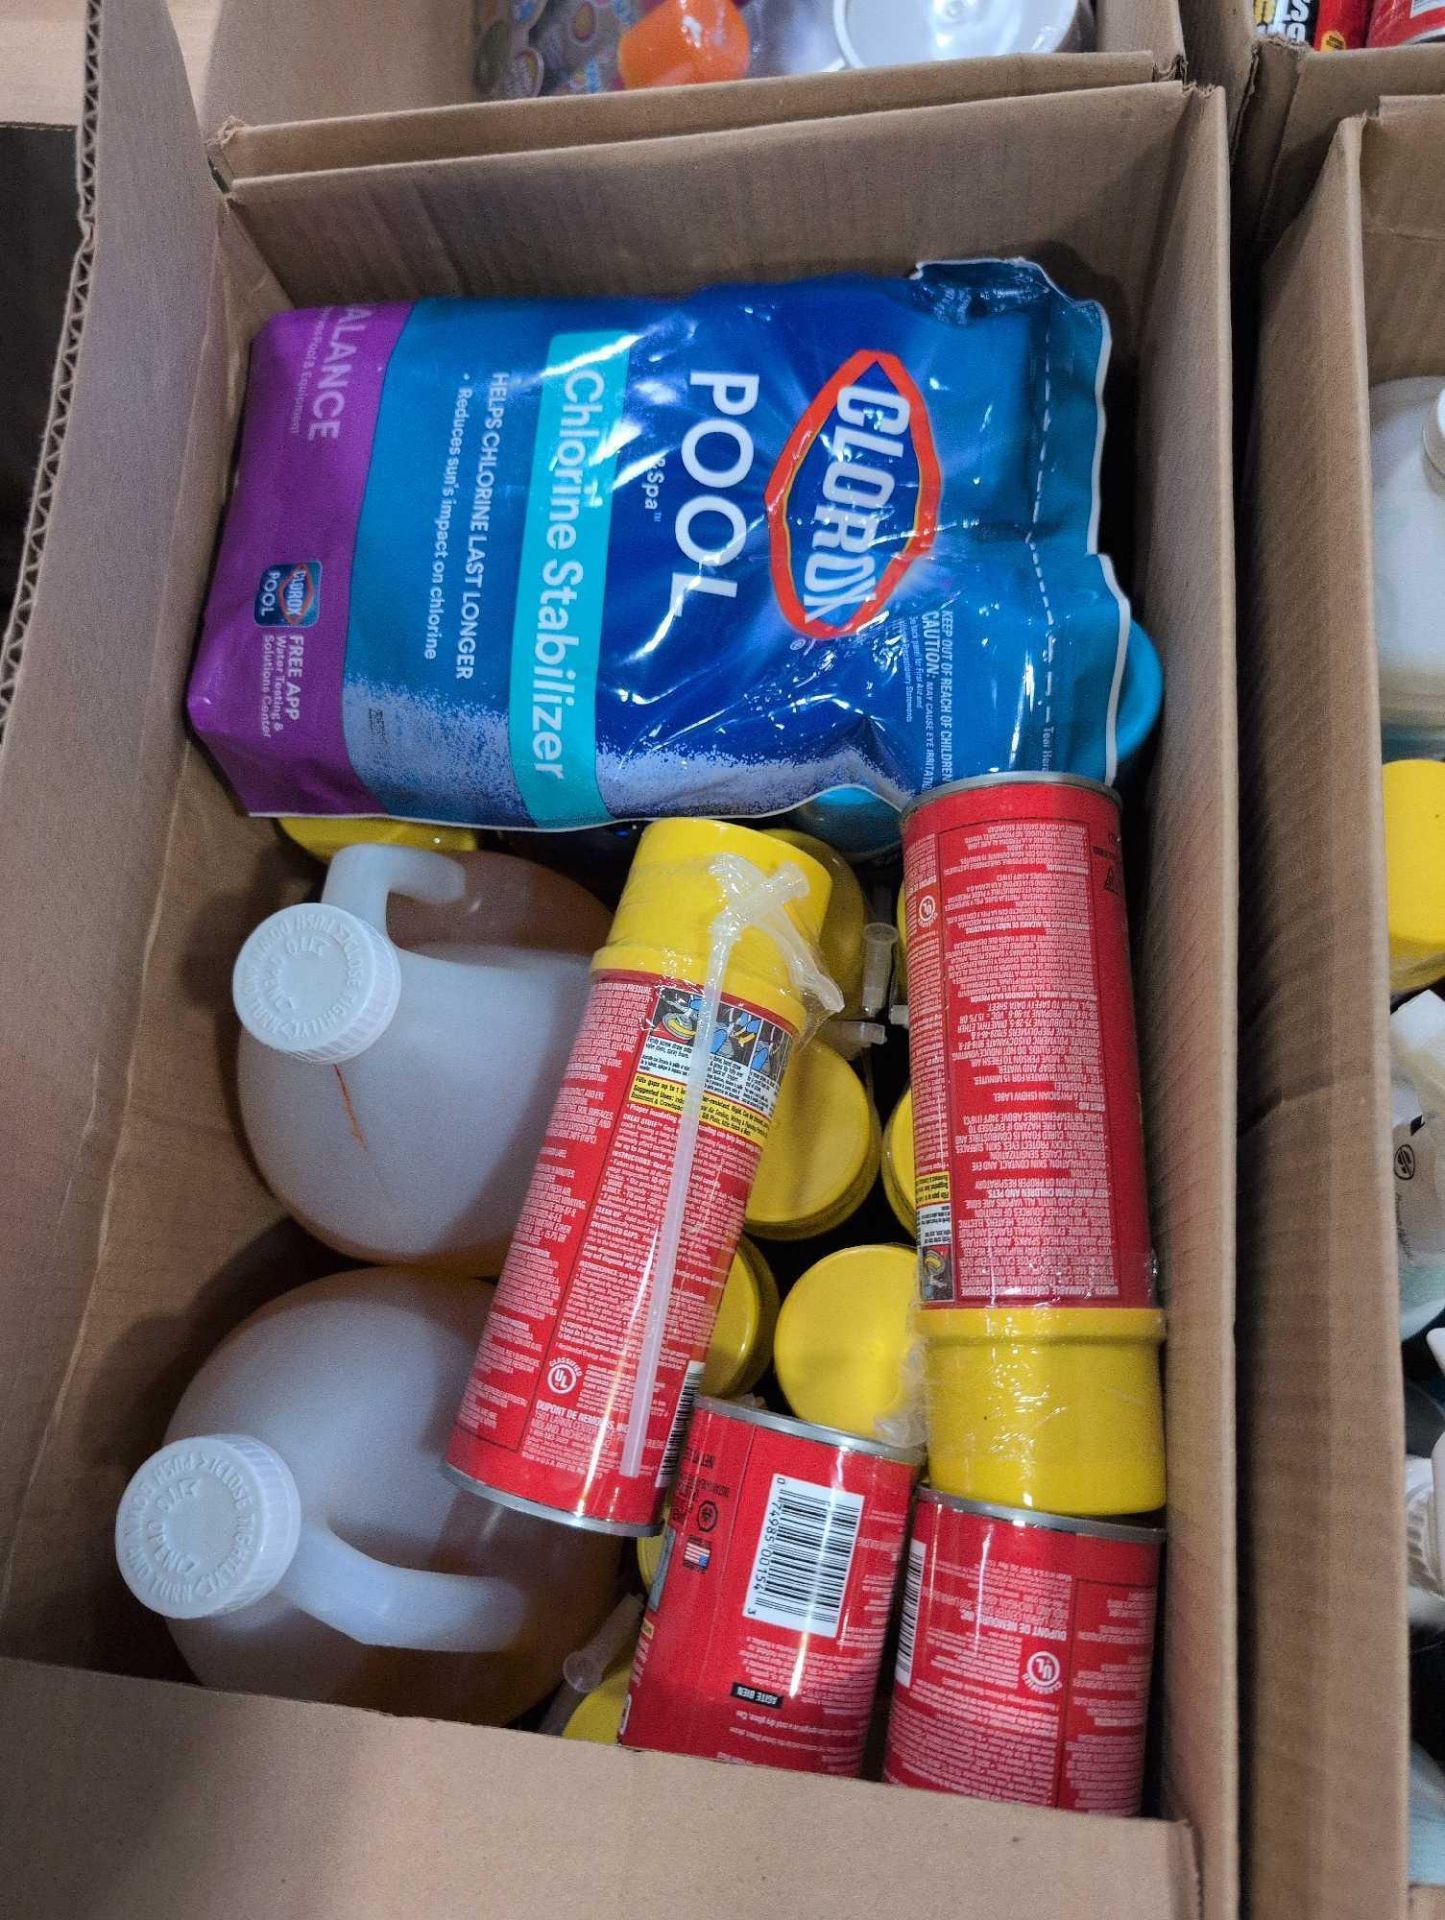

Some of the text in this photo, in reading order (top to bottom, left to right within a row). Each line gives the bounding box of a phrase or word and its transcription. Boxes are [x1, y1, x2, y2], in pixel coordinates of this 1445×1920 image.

[307, 306, 373, 440] ALANCE
[424, 387, 473, 659] Reduces sun's impact on chlorine
[456, 373, 510, 679] HELPS CHLORINE LAST LONGER
[670, 371, 759, 617] POOL
[804, 386, 911, 622] CLOROX
[260, 571, 280, 616] POOL
[285, 570, 307, 616] CLOROX
[532, 370, 605, 779] Chlorine Stabilizer
[941, 610, 953, 637] KEEP
[941, 639, 953, 660] OUT
[941, 664, 953, 676] OF
[260, 634, 274, 737] Solutions Center
[270, 635, 287, 731] Water Testing &
[285, 635, 304, 720] FREE APP
[921, 610, 940, 790] CAUTION: MAY CAUSE EYE IRRITATIO
[940, 677, 953, 712] REACH
[940, 715, 952, 728] OF
[1042, 726, 1054, 748] Tear
[747, 1477, 786, 1615] 0 74985 00154 3
